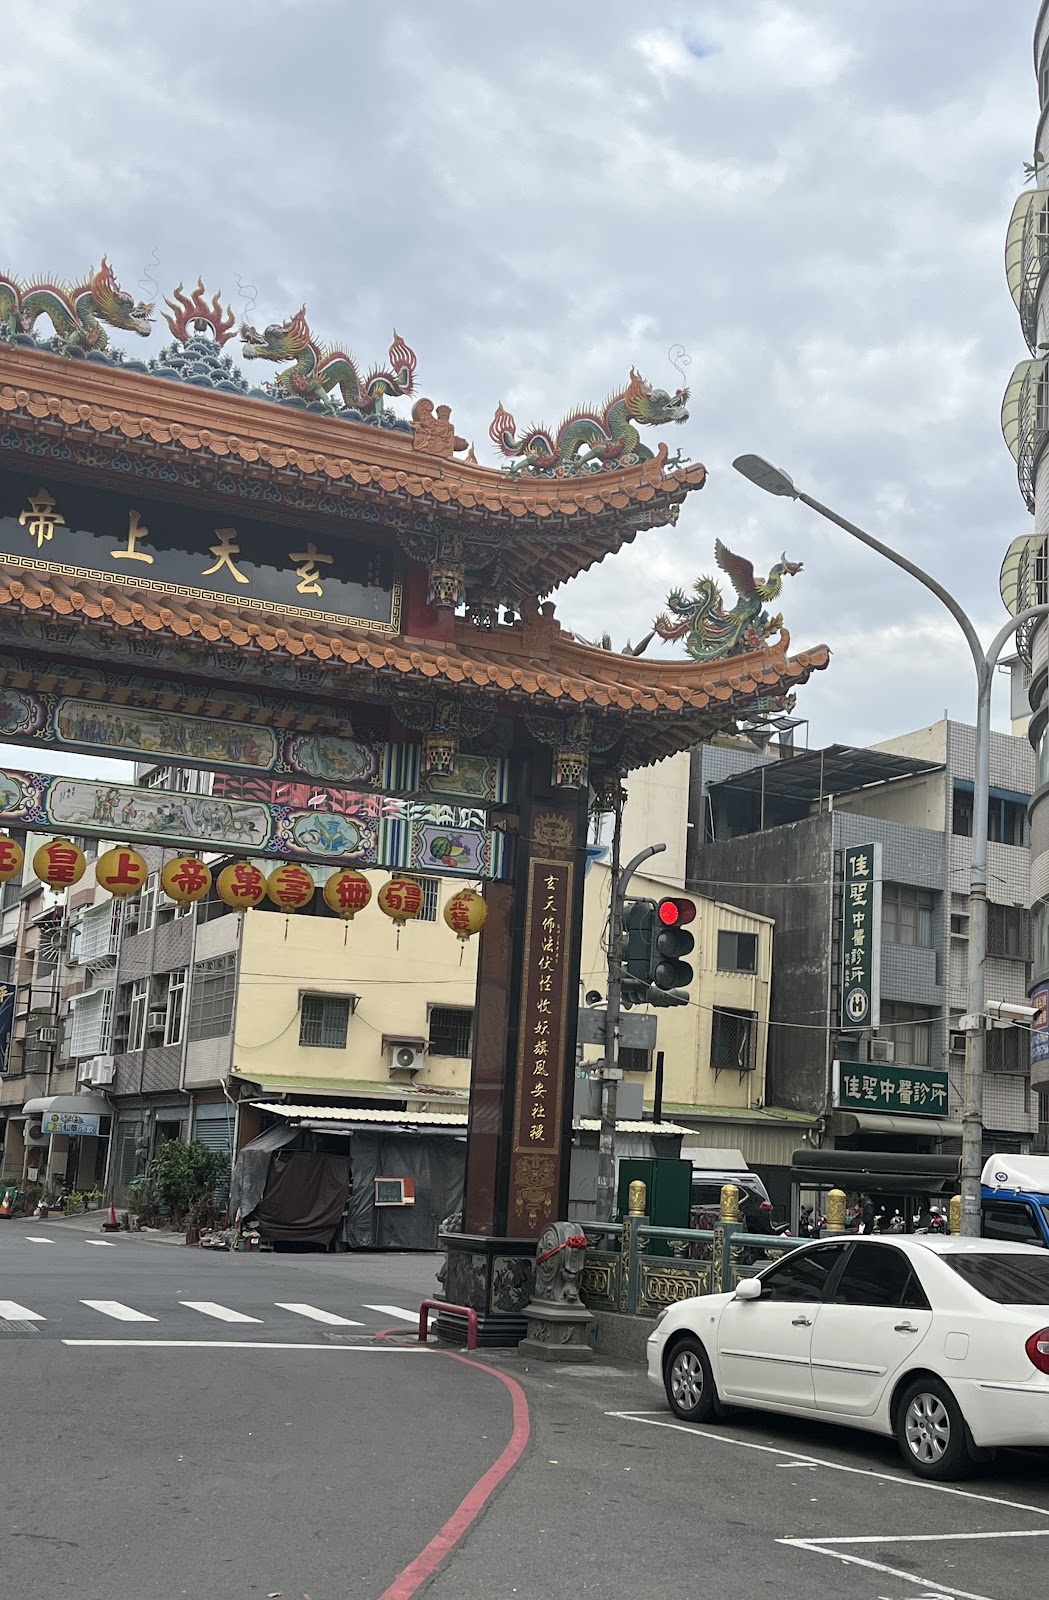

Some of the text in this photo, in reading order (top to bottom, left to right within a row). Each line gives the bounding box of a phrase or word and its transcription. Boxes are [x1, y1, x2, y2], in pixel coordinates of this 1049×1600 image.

[19, 487, 334, 597] 玄天上帝
[849, 853, 870, 983] 佳聖中醫診所
[843, 1075, 948, 1107] 佳聖中醫診所
